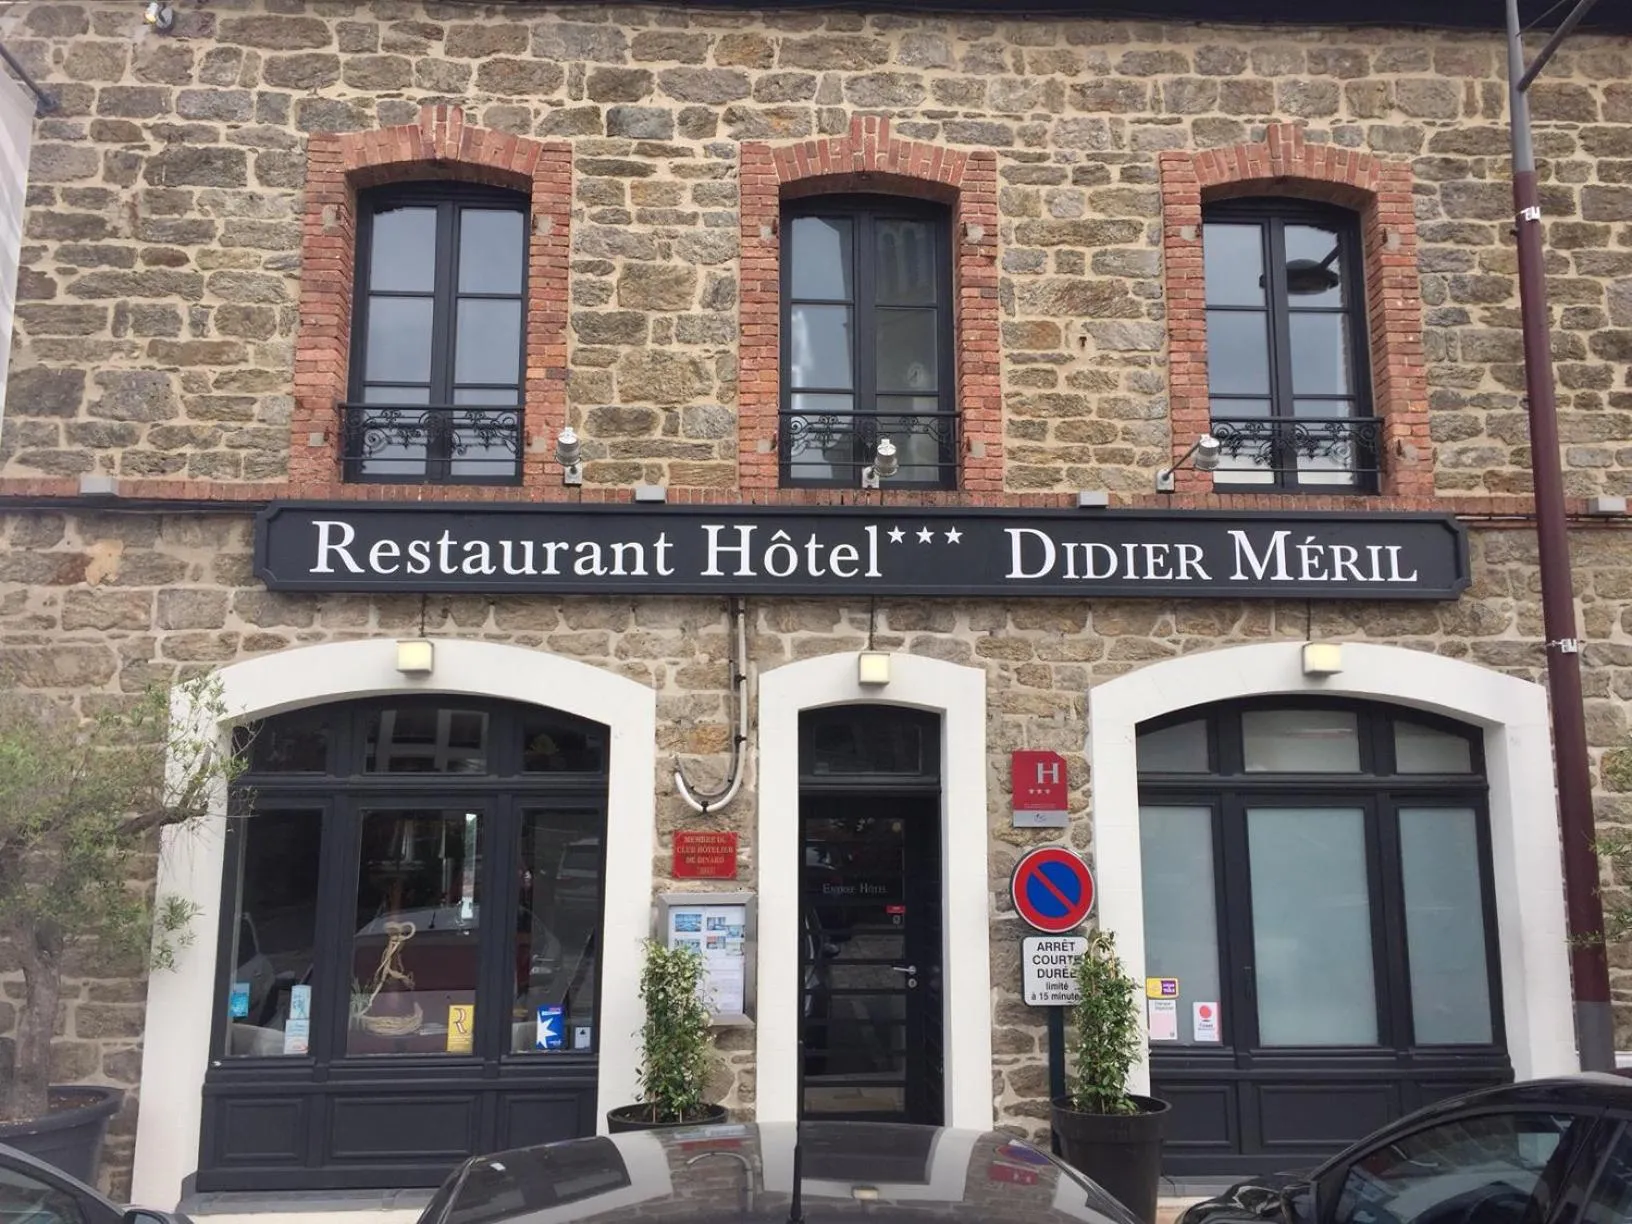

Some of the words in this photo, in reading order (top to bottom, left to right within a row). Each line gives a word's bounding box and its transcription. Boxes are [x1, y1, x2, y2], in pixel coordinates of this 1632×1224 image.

[309, 520, 675, 576] Restaurant
[700, 524, 883, 578] Hôtel
[1003, 527, 1213, 580] DIDIER
[1226, 529, 1418, 582] MÉRIL
[1037, 762, 1060, 784] H
[1036, 939, 1076, 952] ARRÊT
[1031, 954, 1082, 965] COURTE
[1037, 966, 1078, 979] DURÉE
[1045, 982, 1069, 991] limité
[1039, 992, 1049, 1000] 15
[1051, 991, 1081, 1001] minute
